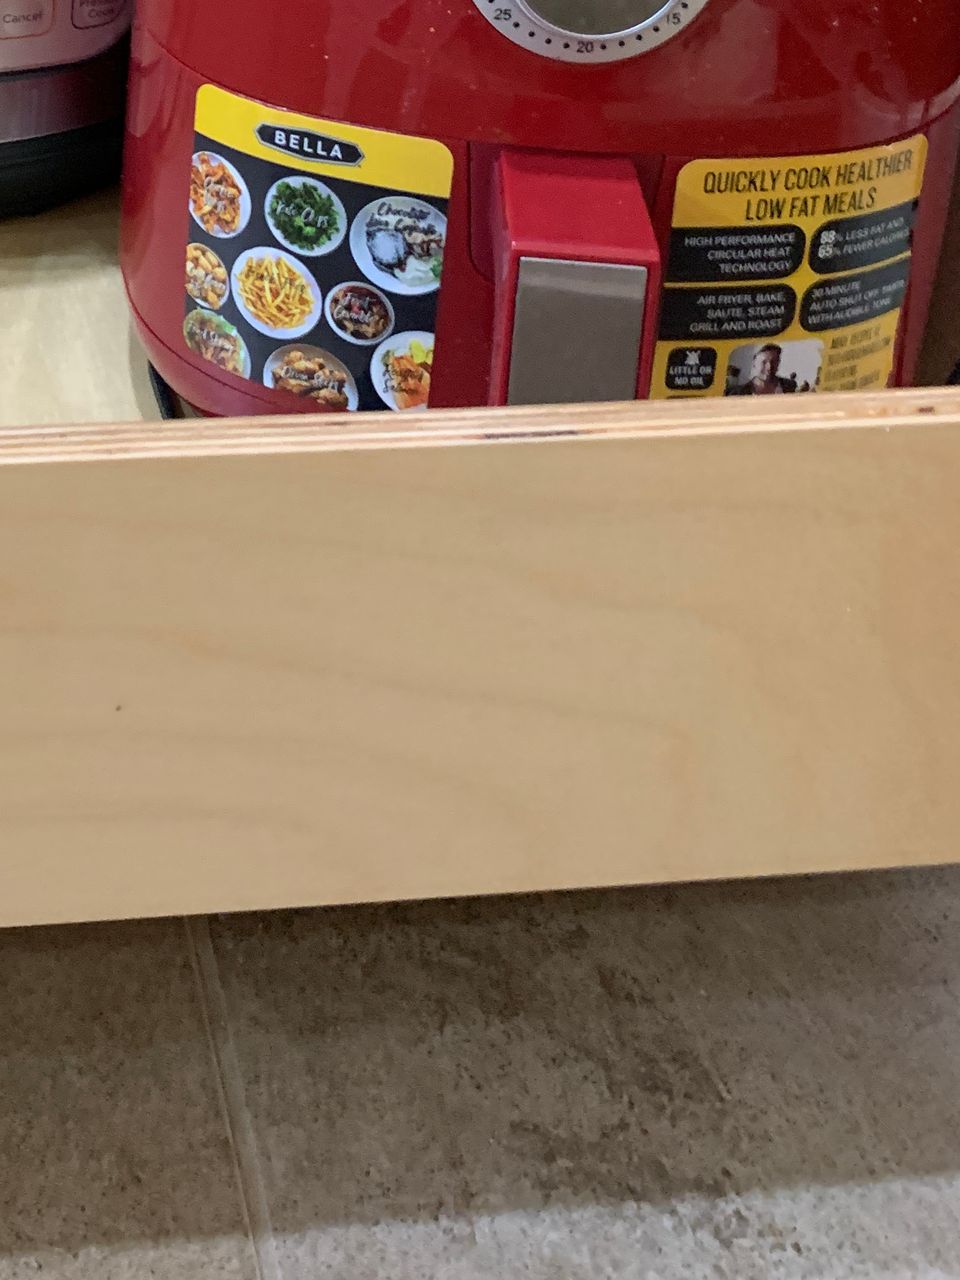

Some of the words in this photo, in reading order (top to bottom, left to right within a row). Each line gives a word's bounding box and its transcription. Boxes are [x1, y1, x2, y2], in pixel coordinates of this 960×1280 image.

[3, 10, 43, 24] Cancel
[494, 8, 511, 20] 25
[577, 40, 593, 53] 20
[274, 130, 343, 160] BELLA
[703, 169, 782, 194] QUICKLY
[783, 166, 832, 191] COOK
[835, 149, 913, 186] HEALTHIER
[745, 197, 787, 221] LOW
[788, 194, 820, 218] FAT
[822, 186, 877, 215] MEALS
[684, 236, 712, 248] HIGH
[714, 232, 795, 247] PERFORMANCE
[707, 249, 761, 261] CIRCULAR
[763, 246, 791, 257] HEAT
[719, 260, 791, 273] TECHNOLOGY
[697, 295, 715, 305] AIR
[690, 321, 719, 332] GRILL
[720, 320, 746, 331] AND
[747, 318, 783, 329] ROAST
